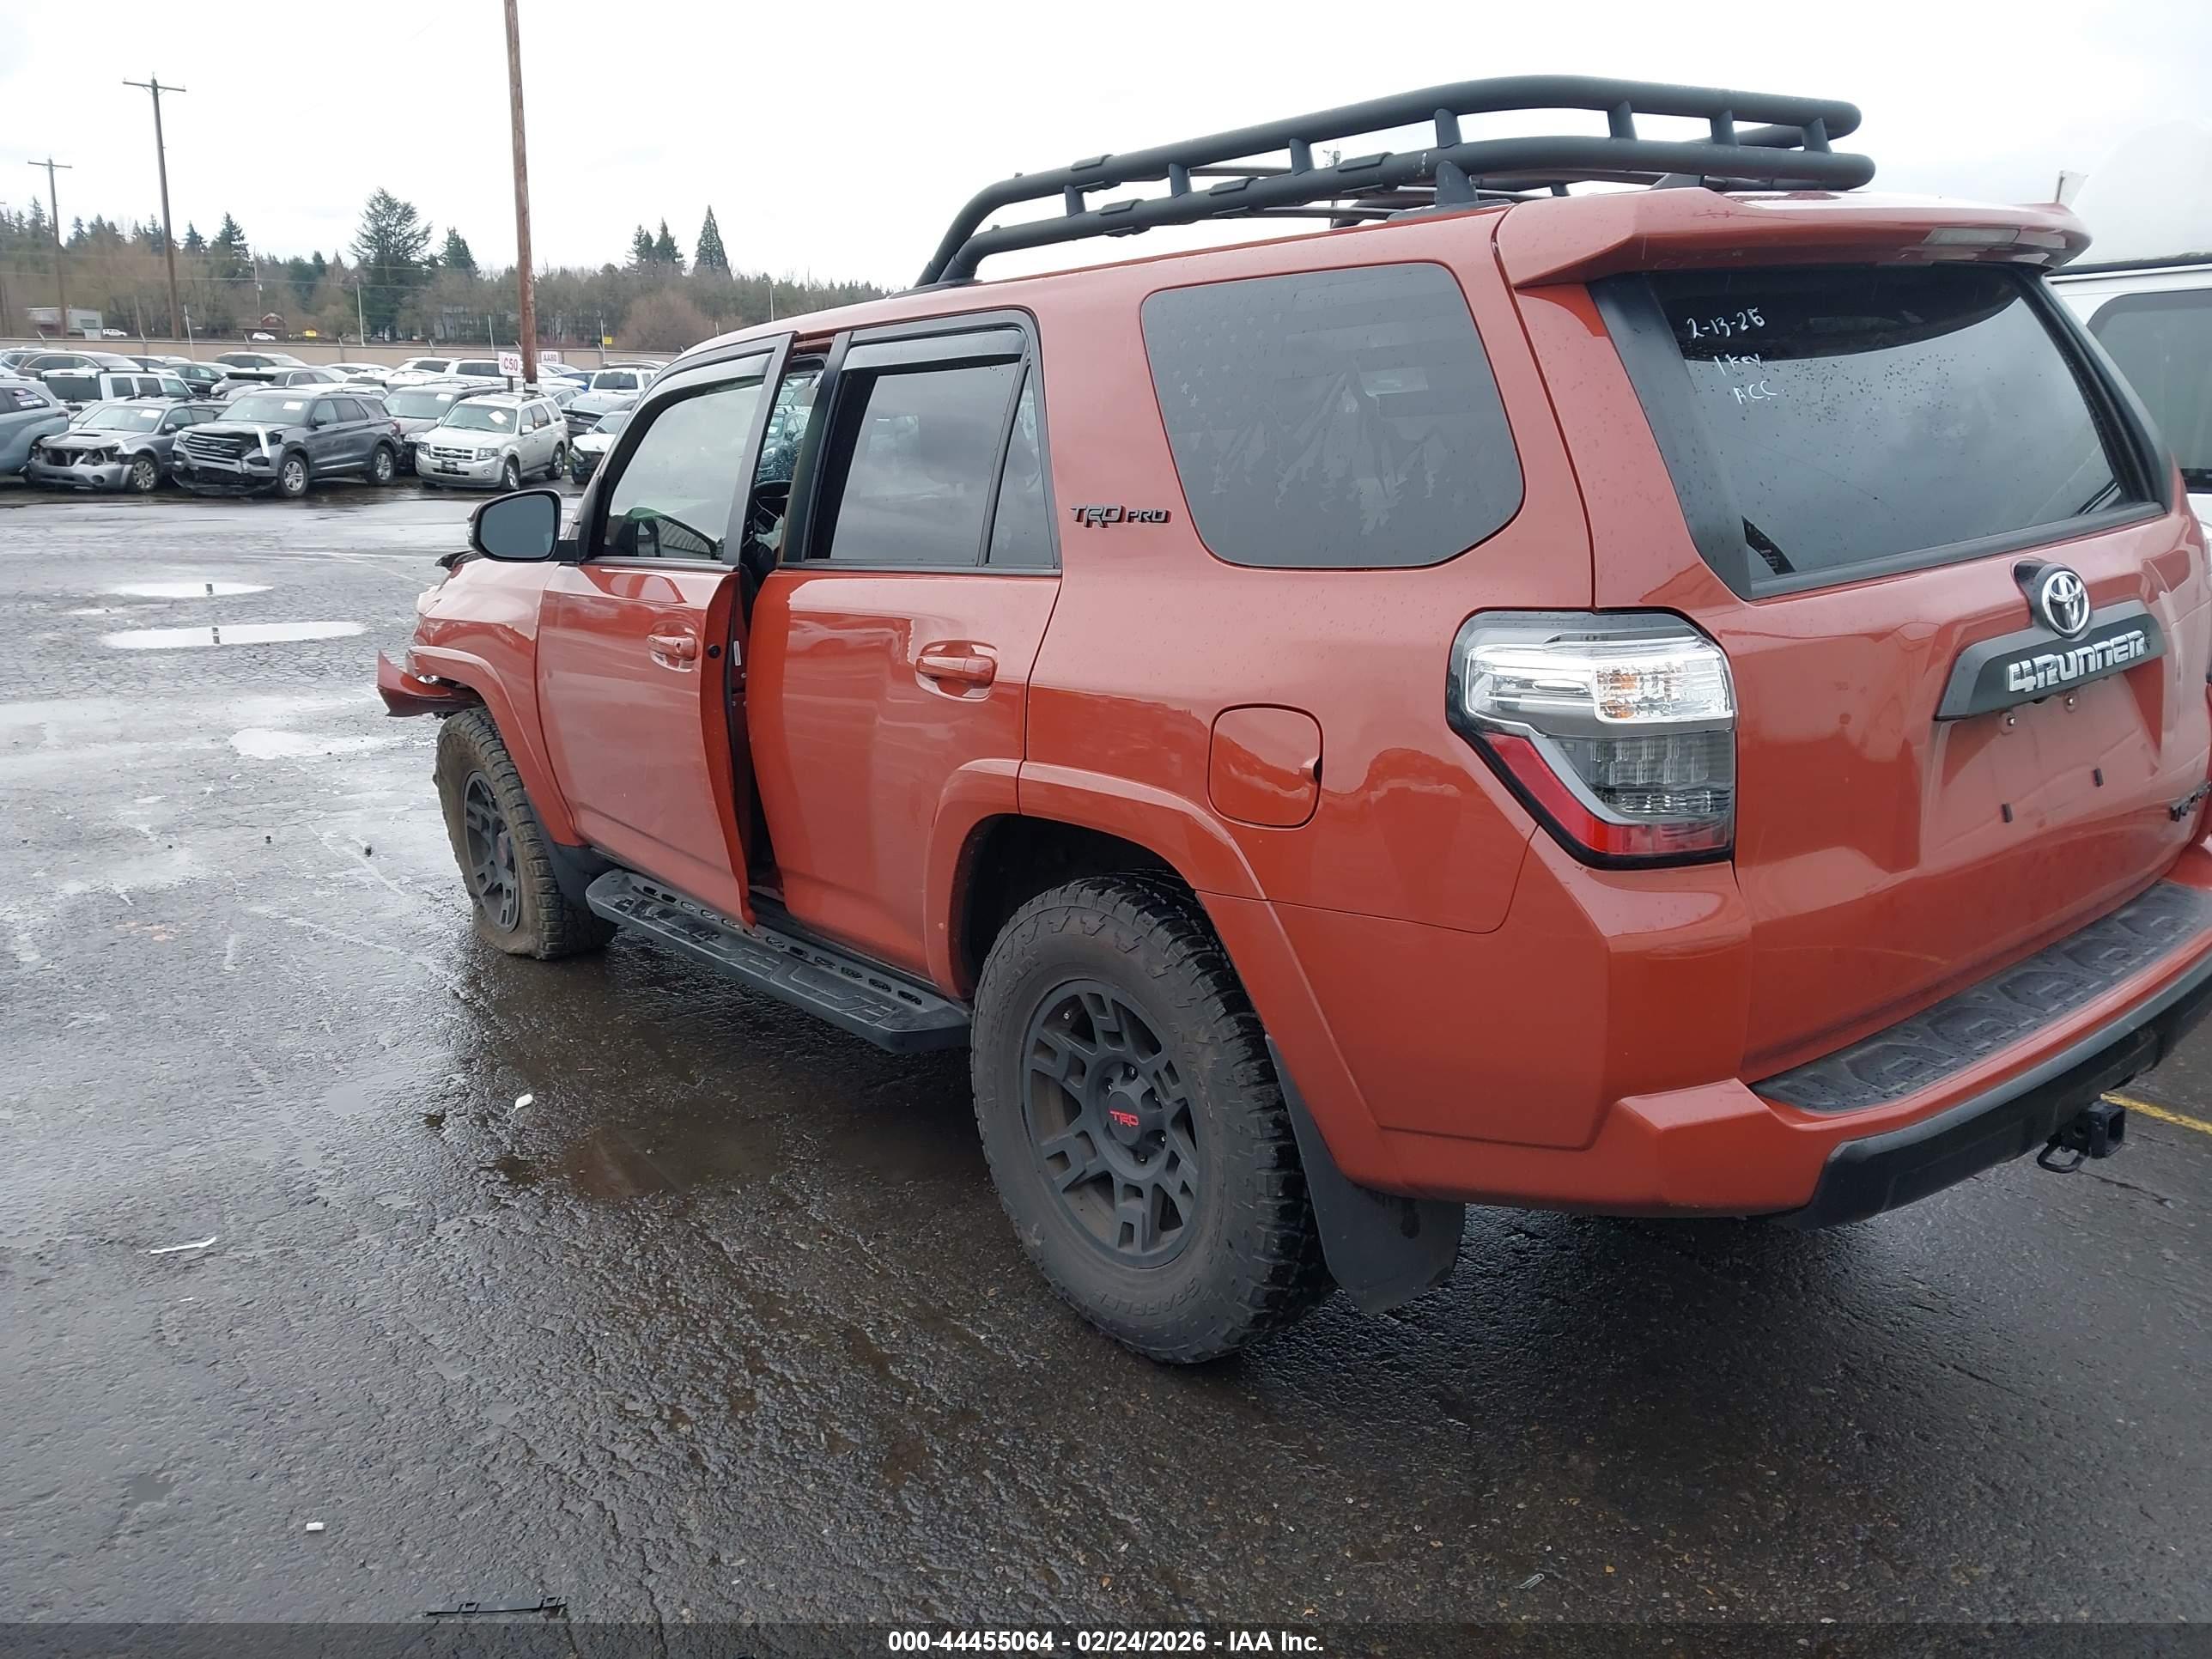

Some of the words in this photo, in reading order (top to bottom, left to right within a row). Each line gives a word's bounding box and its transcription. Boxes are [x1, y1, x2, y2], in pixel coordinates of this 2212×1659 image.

[1070, 504, 1127, 529] TRD
[1126, 508, 1172, 524] PRO
[2008, 629, 2147, 693] 4RUNNER
[1109, 1109, 1139, 1127] TRD
